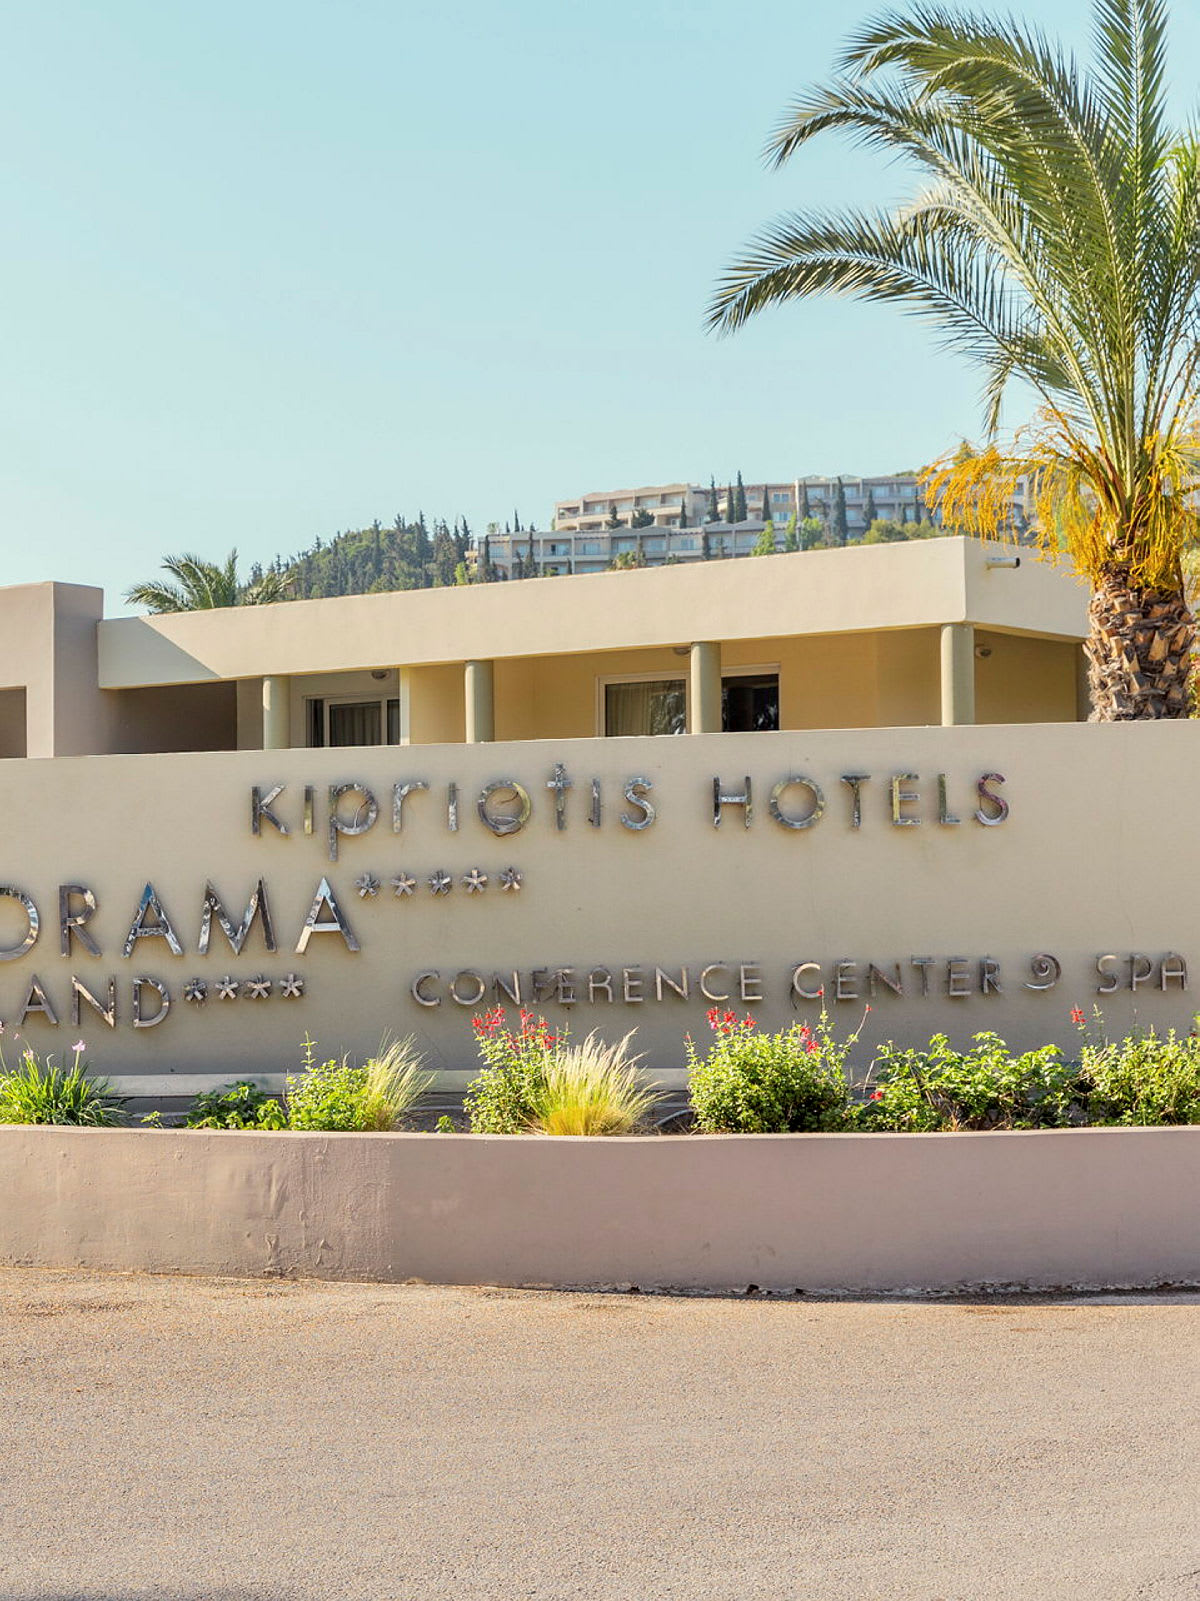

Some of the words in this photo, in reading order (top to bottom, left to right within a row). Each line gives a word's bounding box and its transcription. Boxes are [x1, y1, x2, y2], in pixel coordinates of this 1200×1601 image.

[712, 773, 1009, 829] HOTELS
[411, 961, 763, 1006] CONFERENCE
[792, 954, 1001, 1000] CENTER
[1096, 951, 1189, 992] SPA
